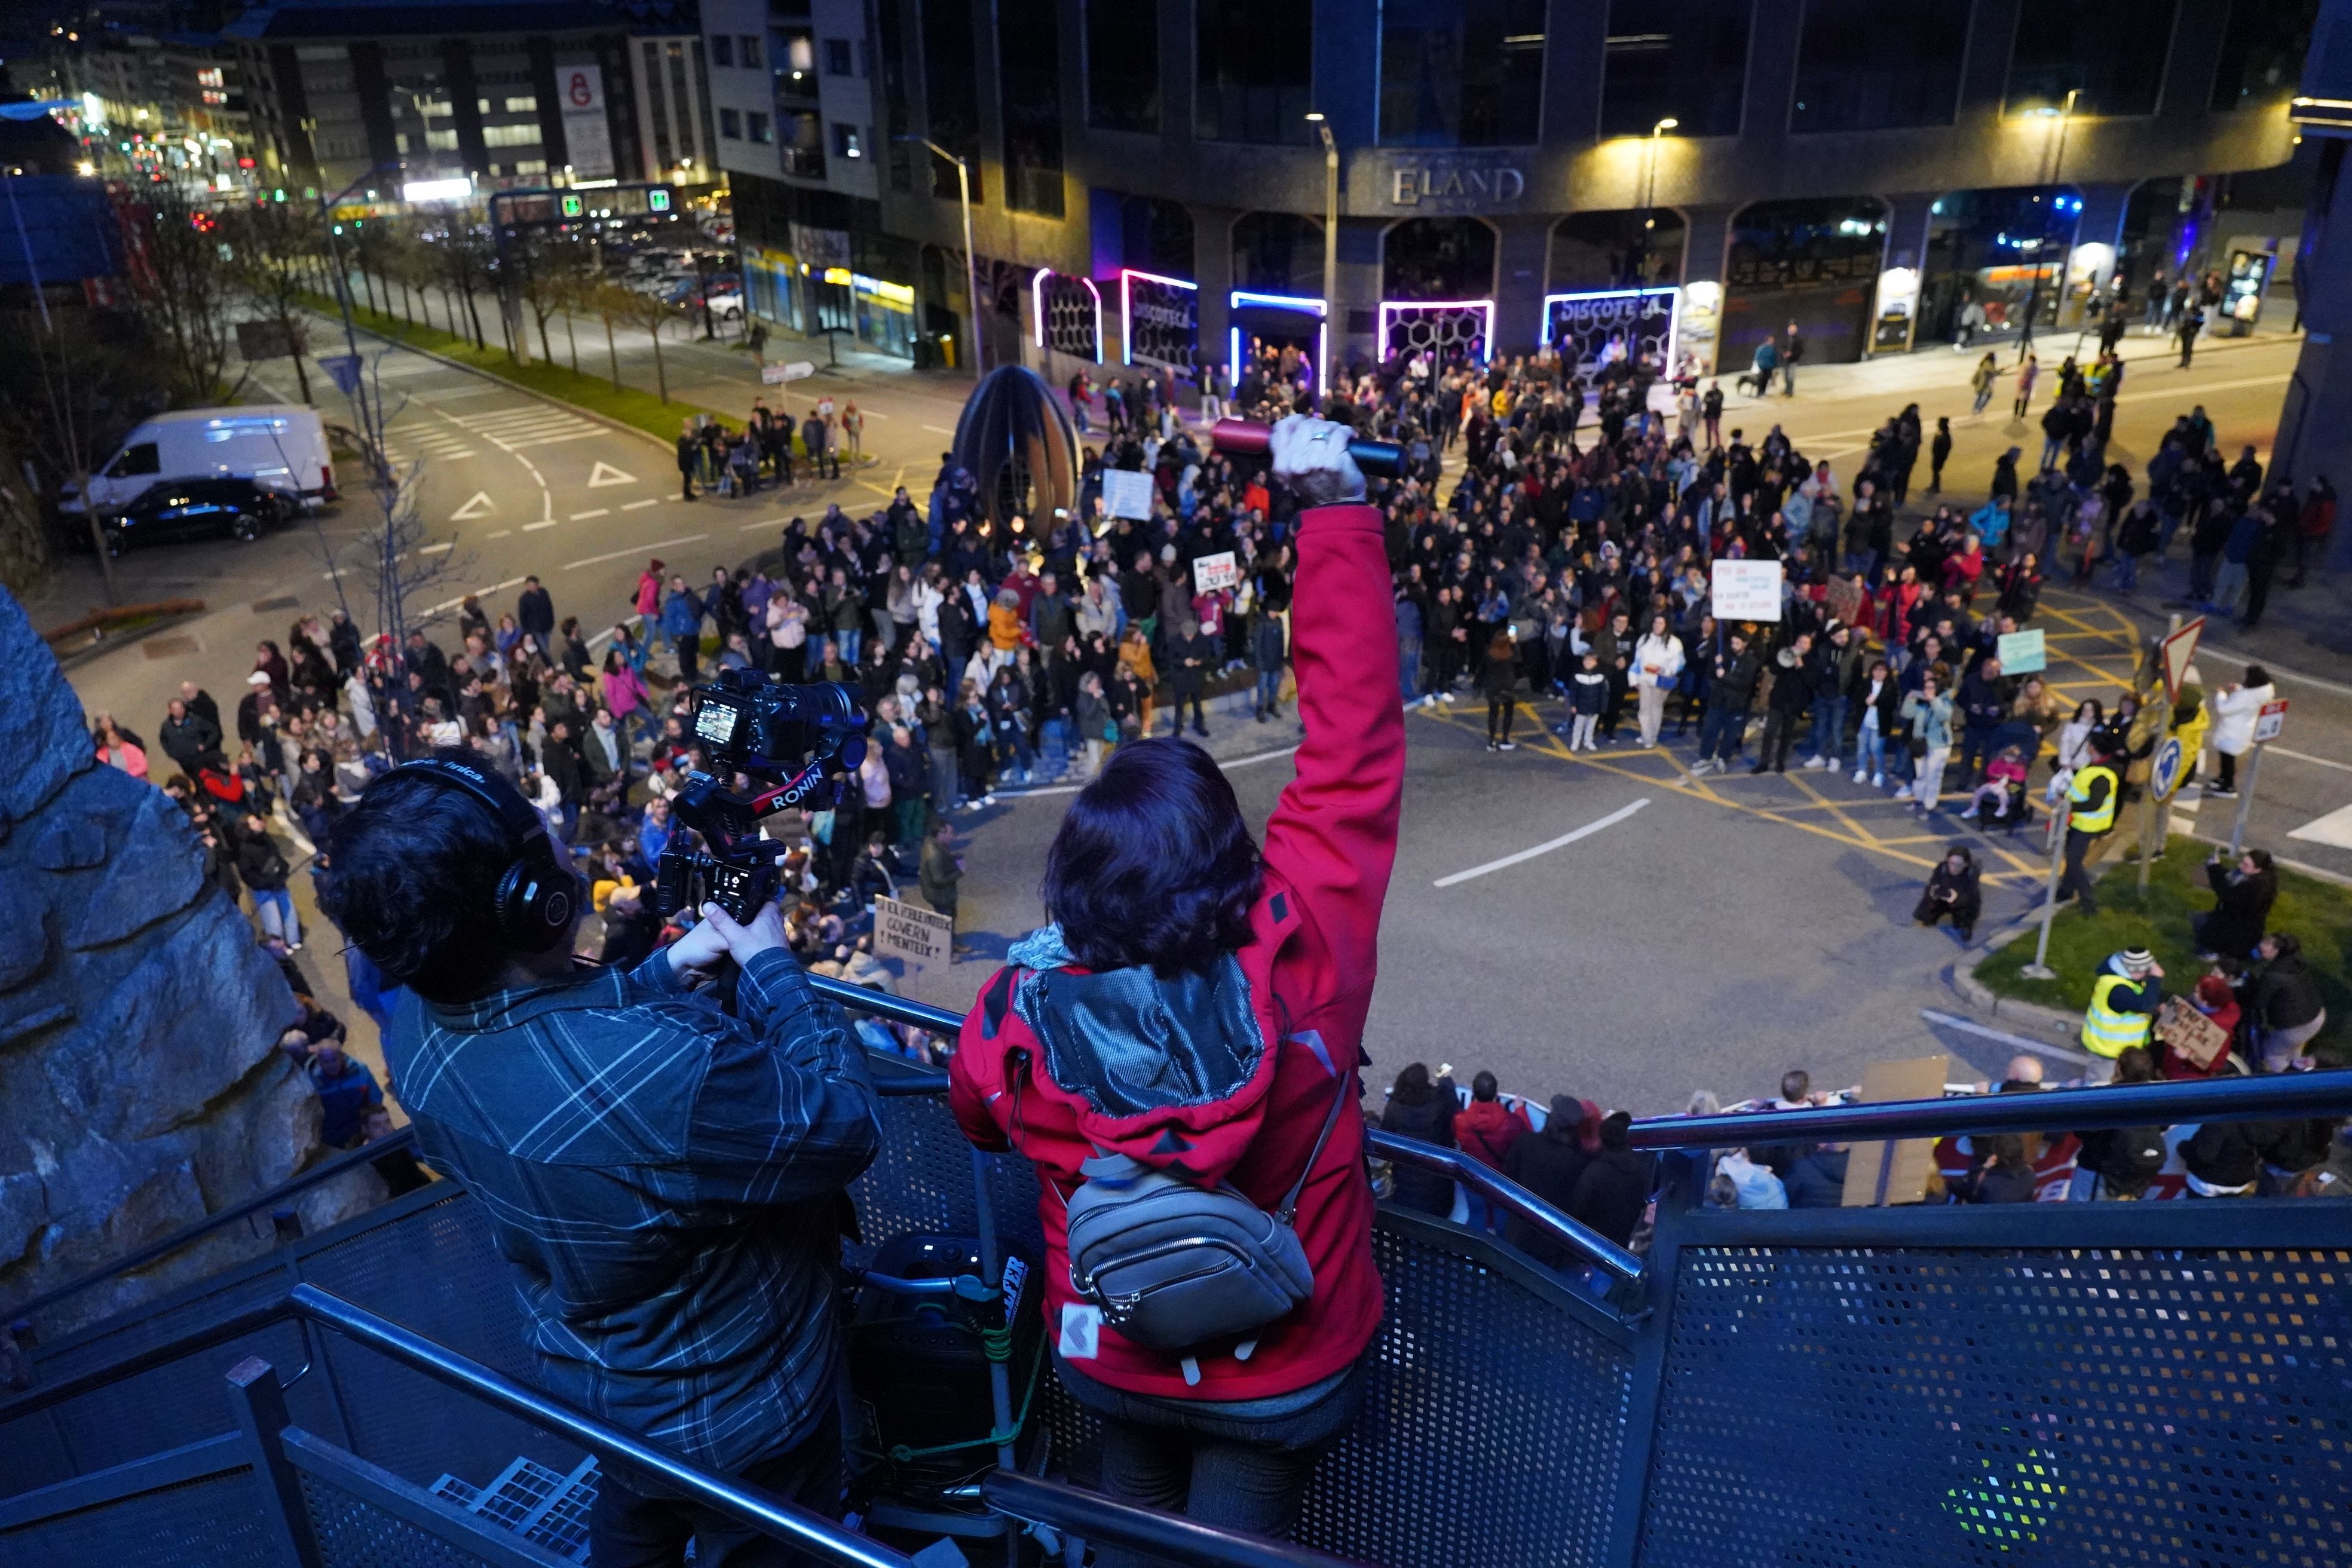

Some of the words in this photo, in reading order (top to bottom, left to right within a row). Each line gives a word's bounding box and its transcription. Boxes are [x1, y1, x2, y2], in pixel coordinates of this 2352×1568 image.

[1393, 168, 1524, 204] ELAND
[1560, 296, 1662, 321] DISCOTEA
[771, 768, 823, 809] RONIN
[887, 917, 930, 942] GOVERN
[1003, 1256, 1026, 1324] LFER
